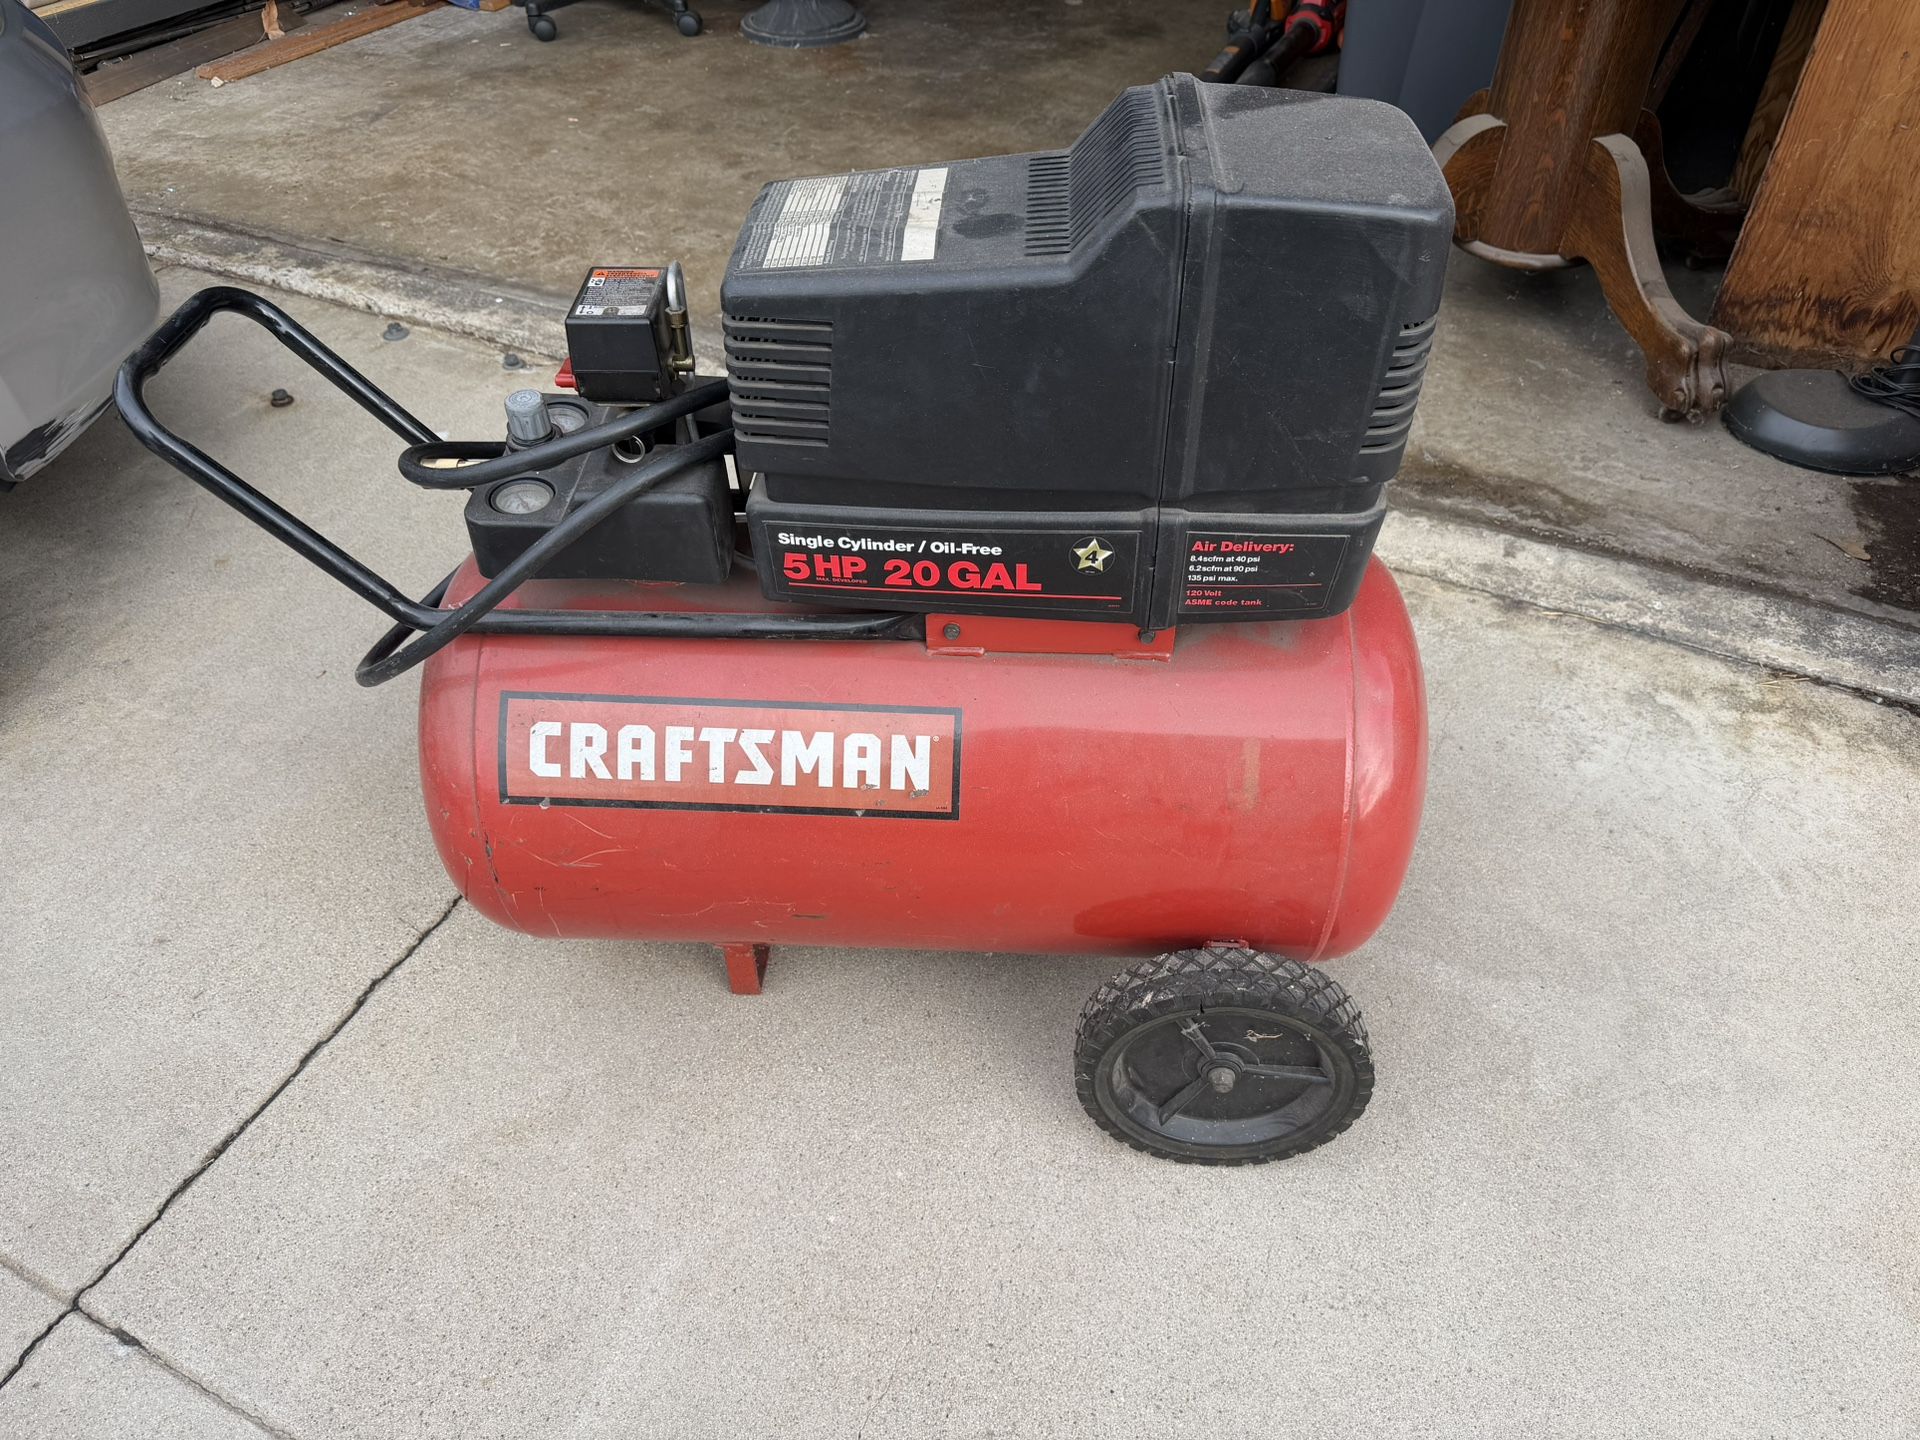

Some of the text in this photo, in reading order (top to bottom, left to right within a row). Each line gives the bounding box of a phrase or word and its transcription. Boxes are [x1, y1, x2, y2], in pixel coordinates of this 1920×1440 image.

[778, 532, 834, 549] Single
[837, 536, 914, 552] Cylinder
[930, 541, 1003, 556] Oil-Free
[1192, 541, 1294, 554] Air Delivery:
[1085, 550, 1099, 564] 4
[883, 558, 940, 587] 20
[948, 560, 1042, 591] GAL
[529, 721, 932, 793] CRAFTSMAN
